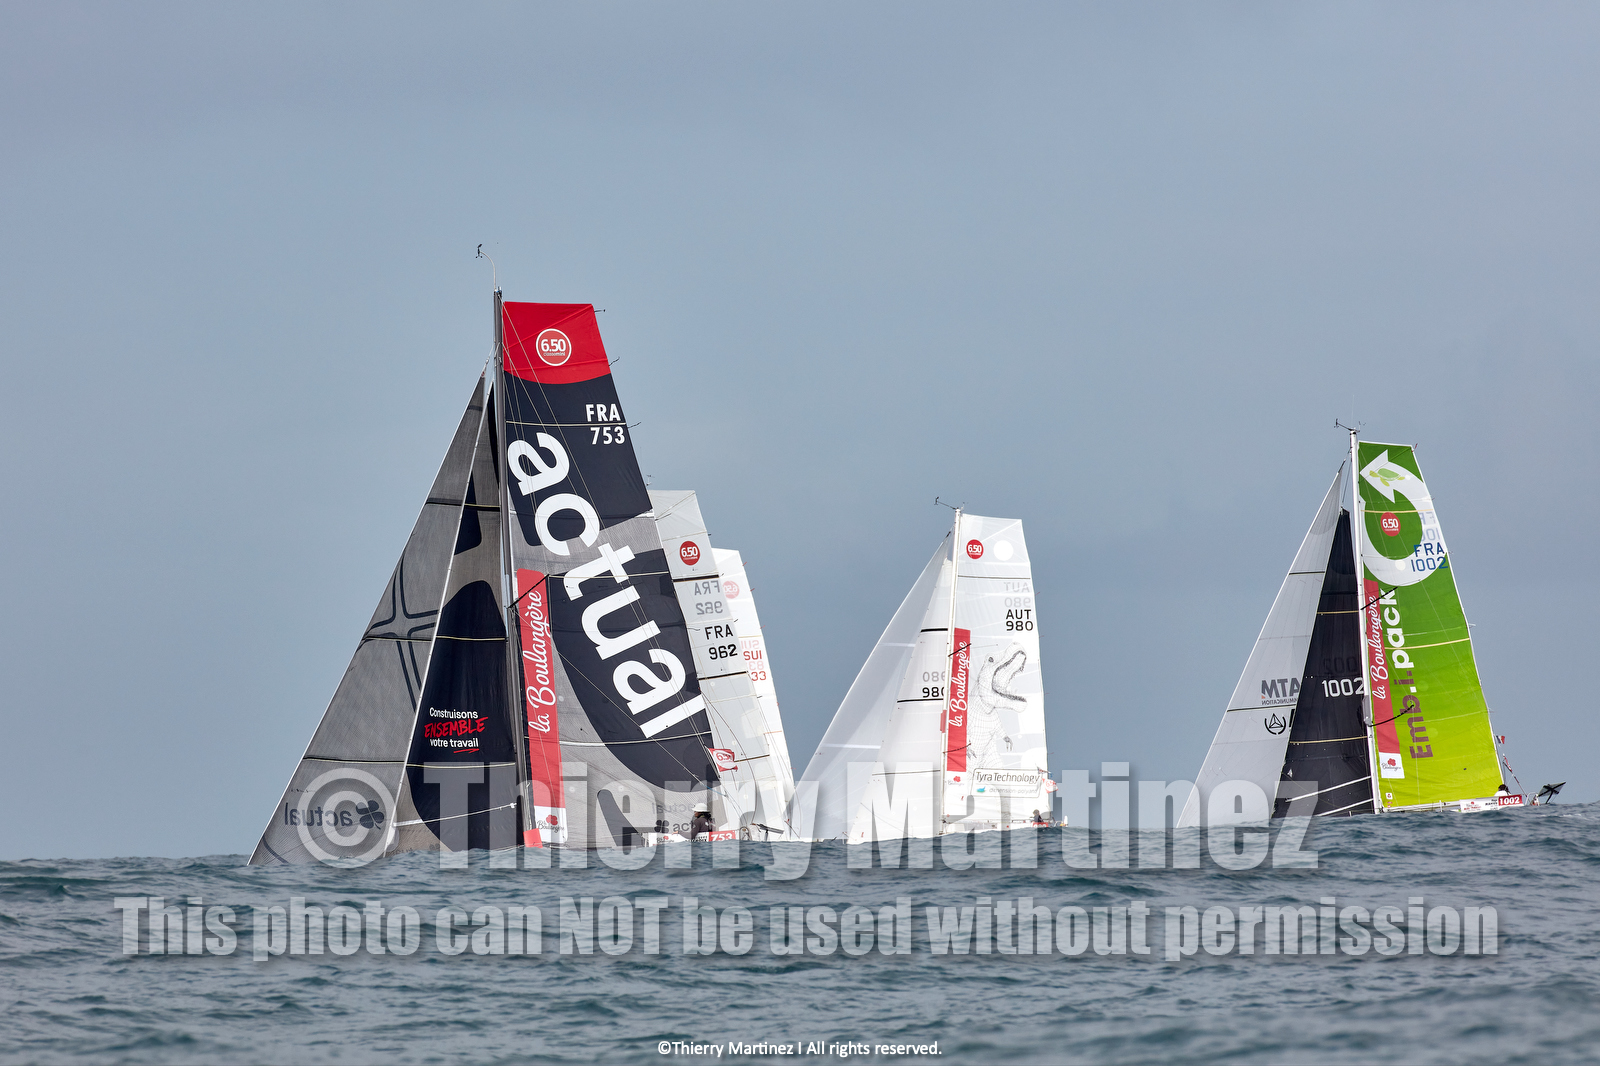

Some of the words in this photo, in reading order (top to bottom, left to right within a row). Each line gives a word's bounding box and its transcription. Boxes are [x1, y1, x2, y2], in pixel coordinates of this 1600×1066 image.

[541, 339, 566, 352] 6.50
[585, 403, 621, 422] FRA
[590, 426, 625, 445] 753
[1382, 518, 1399, 529] 6.50
[681, 546, 698, 557] 6.50
[1413, 542, 1444, 557] FRA
[1411, 556, 1448, 572] 1002
[507, 432, 706, 738] actual
[1005, 609, 1032, 620] AUT
[705, 624, 733, 640] FRA
[1005, 620, 1034, 631] 980
[1367, 595, 1389, 681] Boulangère
[522, 590, 557, 708] Boulangère
[708, 644, 738, 660] 962
[743, 650, 763, 660] SUI
[950, 641, 970, 712] Boulangère
[1321, 677, 1364, 697] 1002
[1372, 685, 1386, 699] la
[429, 707, 478, 719] Construisons
[424, 717, 488, 738] ENSEMBLE
[528, 713, 550, 734] la
[949, 715, 963, 727] la
[430, 738, 448, 747] votre
[450, 738, 478, 748] travail
[994, 772, 1040, 784] Technology
[1500, 797, 1520, 805] 1002
